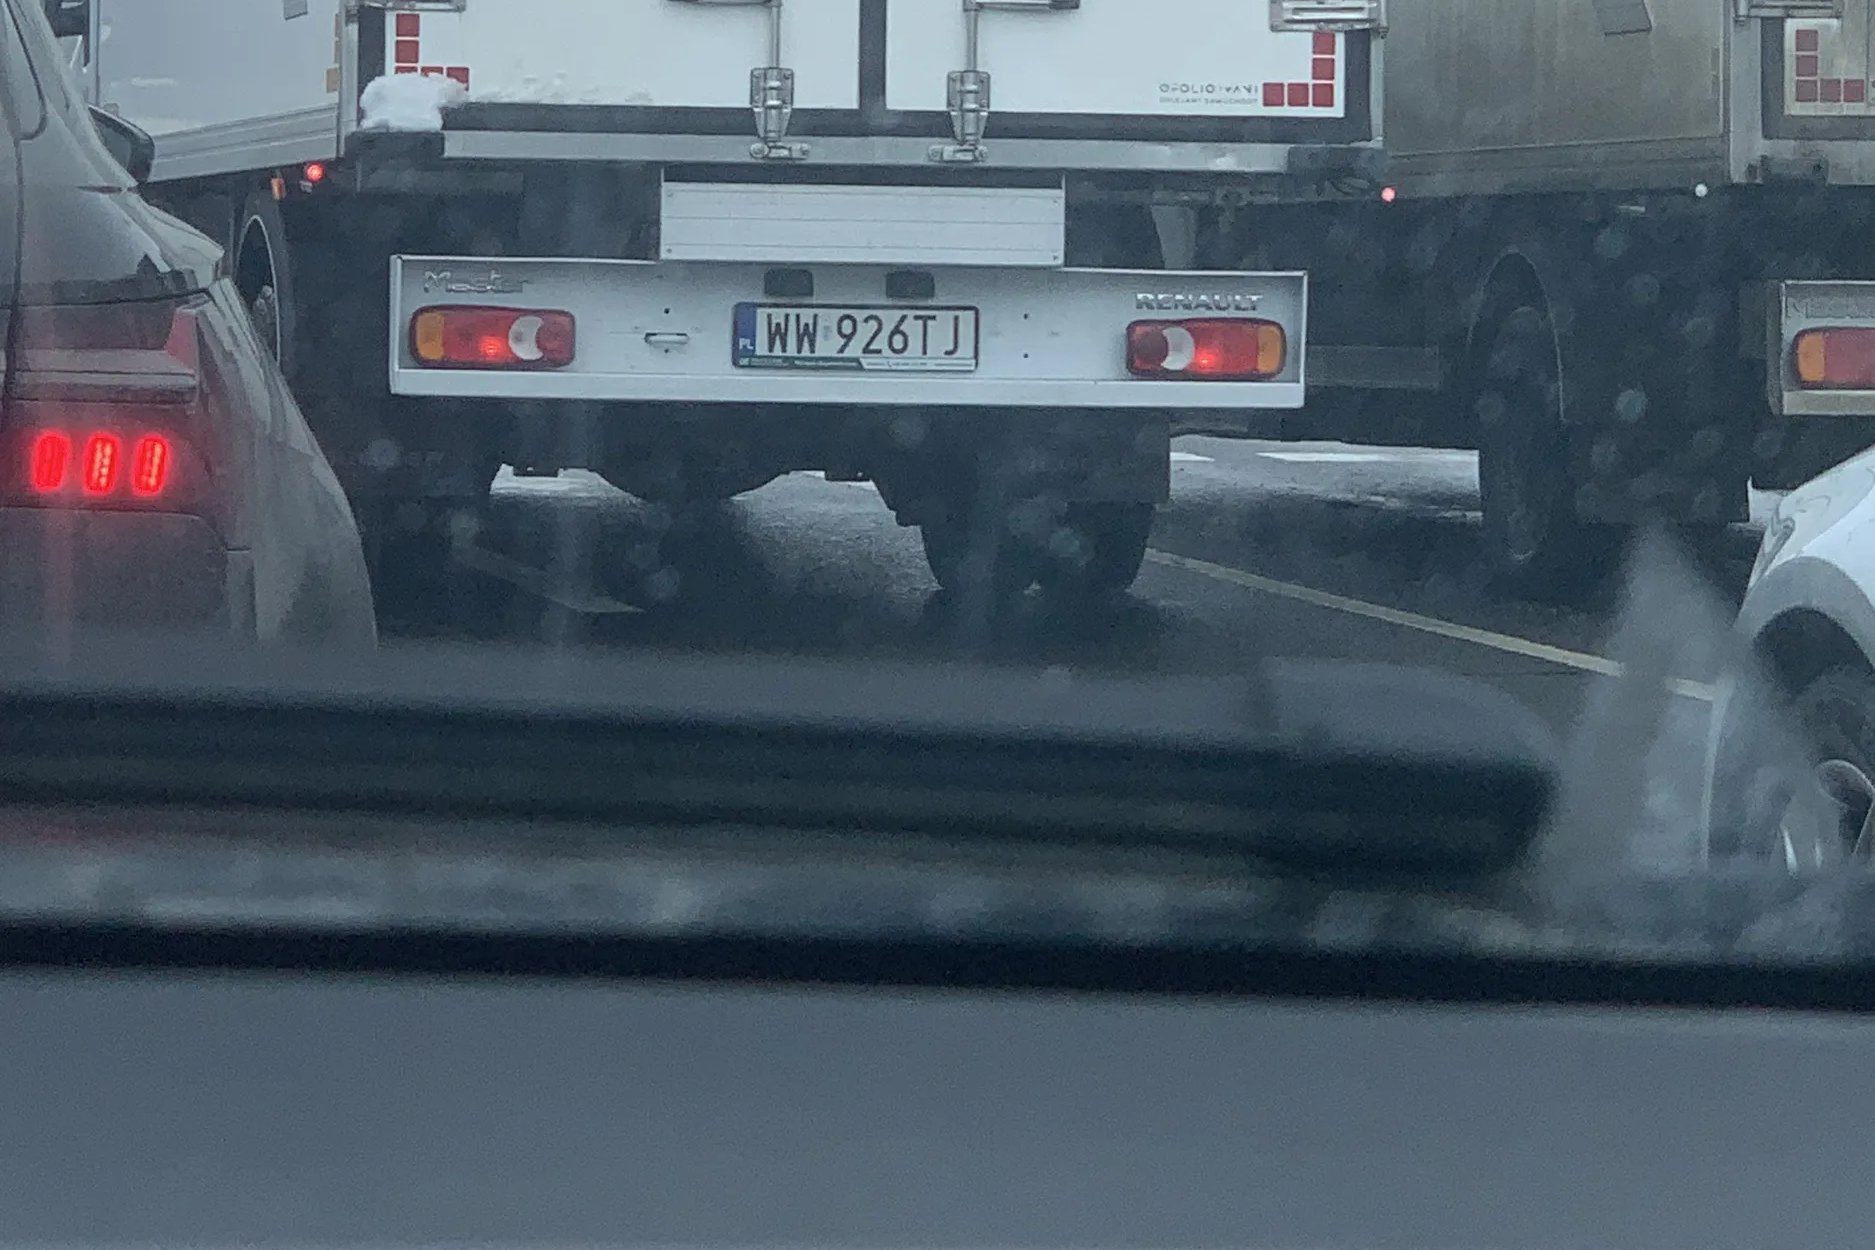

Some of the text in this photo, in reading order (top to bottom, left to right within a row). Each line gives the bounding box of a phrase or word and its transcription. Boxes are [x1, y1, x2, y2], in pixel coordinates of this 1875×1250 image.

[1135, 293, 1263, 312] RENAULT
[739, 337, 754, 350] PL
[766, 313, 960, 356] WW 926TJ
